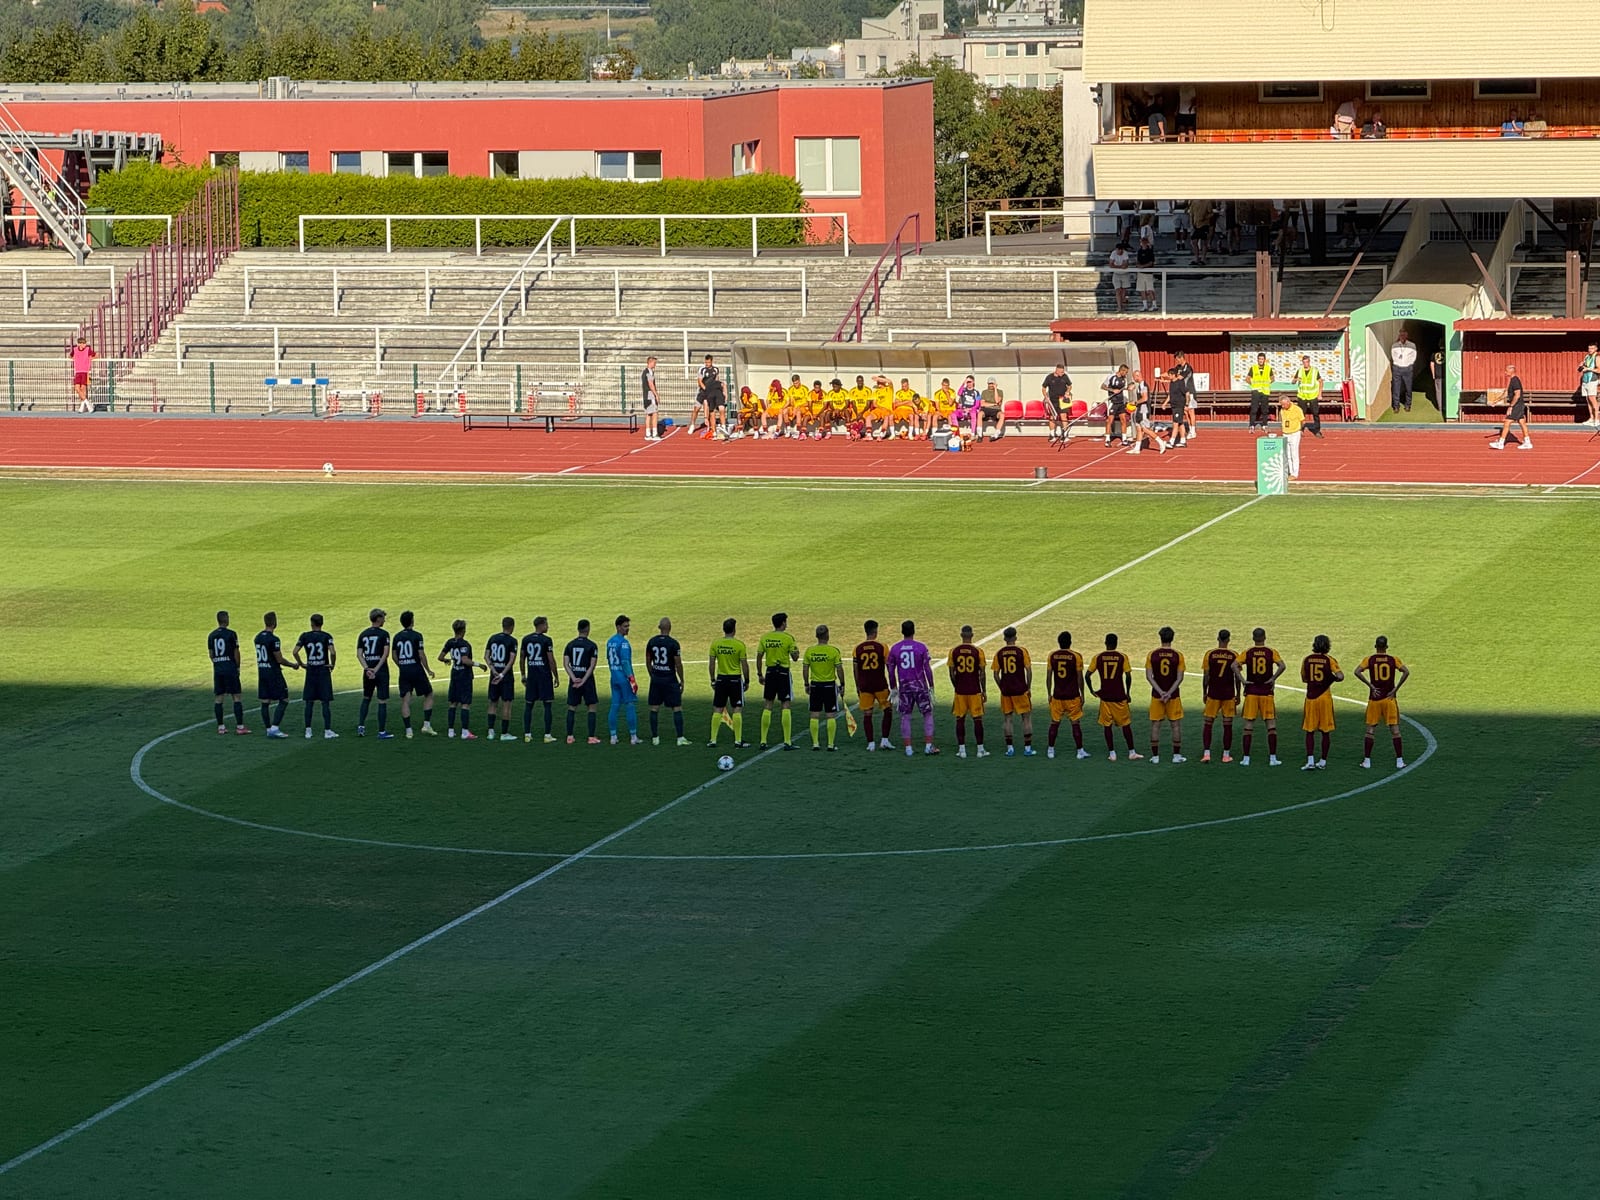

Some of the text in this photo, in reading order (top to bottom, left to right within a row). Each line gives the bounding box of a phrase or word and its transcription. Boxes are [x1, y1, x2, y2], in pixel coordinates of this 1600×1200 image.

[214, 637, 226, 657] 19
[255, 643, 268, 662] 50
[307, 642, 324, 660] 23
[362, 635, 378, 655] 37
[397, 640, 413, 659] 20
[491, 642, 506, 662] 80
[526, 642, 543, 661] 92
[572, 647, 585, 666] 17
[652, 646, 668, 665] 33
[860, 651, 879, 670] 23
[900, 651, 915, 669] 31
[956, 655, 975, 673] 39
[1003, 655, 1017, 674] 16
[1057, 661, 1067, 679] 5
[1103, 661, 1118, 680] 17
[1160, 658, 1170, 676] 6
[1217, 659, 1228, 678] 7
[1252, 656, 1267, 675] 18
[1309, 663, 1324, 682] 15
[1373, 663, 1391, 681] 10
